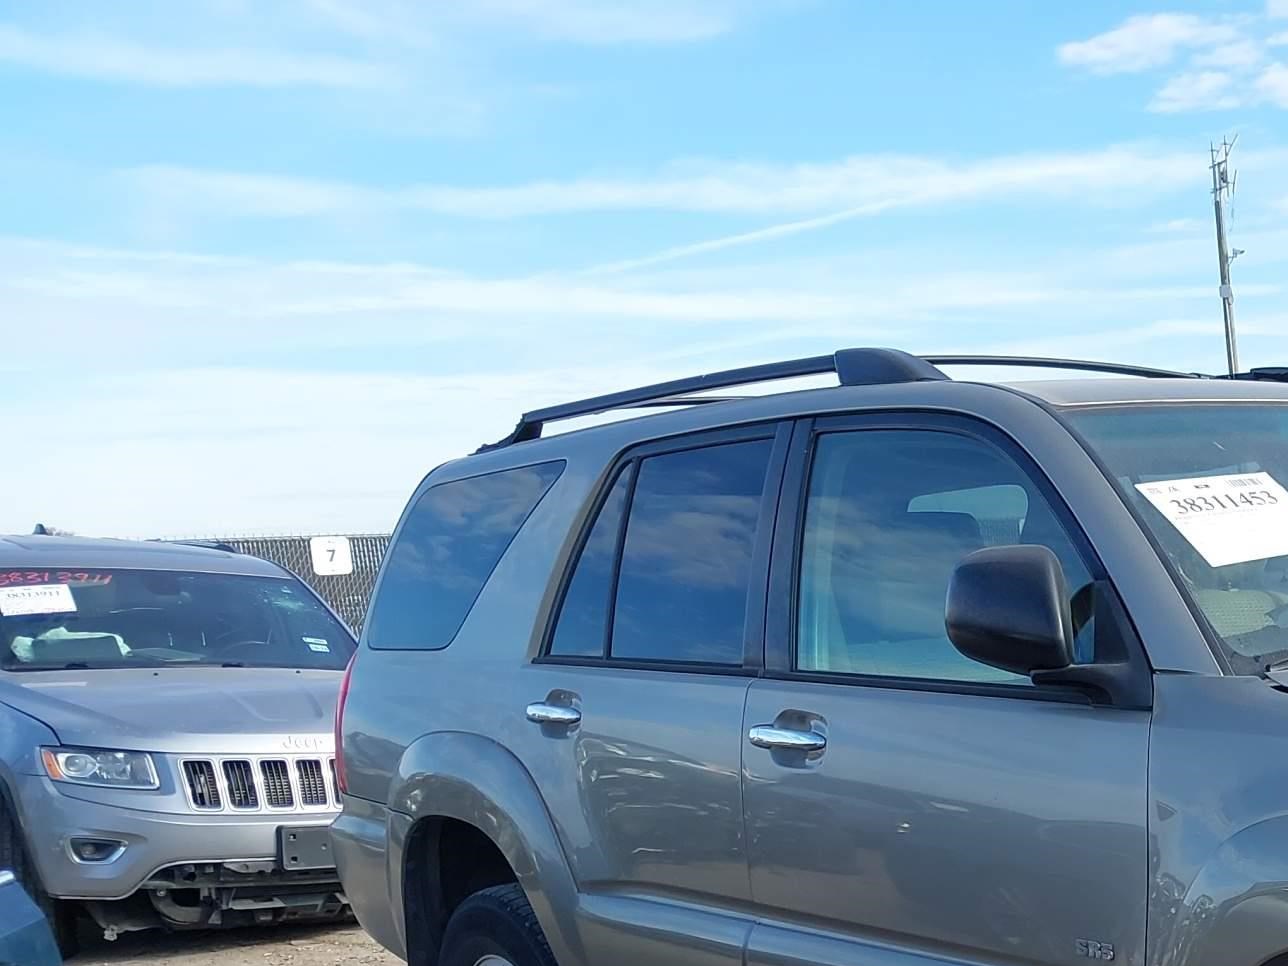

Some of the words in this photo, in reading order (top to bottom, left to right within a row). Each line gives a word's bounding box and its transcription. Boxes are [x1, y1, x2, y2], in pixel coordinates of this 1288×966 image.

[1169, 490, 1279, 515] 38311453
[326, 549, 336, 562] 7
[1075, 937, 1115, 960] SR5
